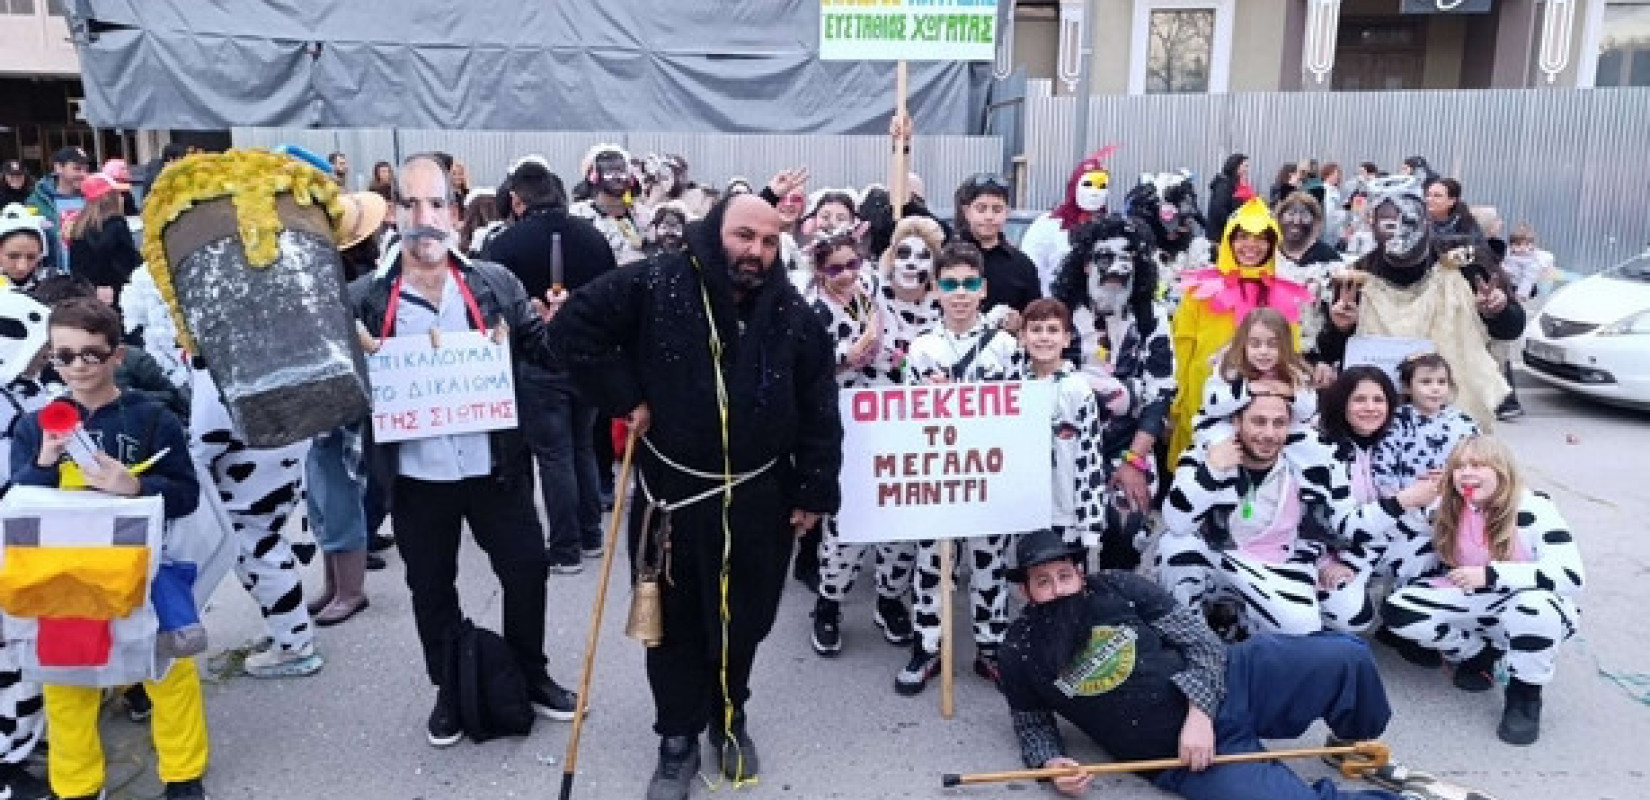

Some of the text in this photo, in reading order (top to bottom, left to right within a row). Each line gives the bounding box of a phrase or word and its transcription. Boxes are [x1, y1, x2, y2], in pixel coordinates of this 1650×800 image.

[372, 371, 510, 402] ΤΟ ΔΙΚΑΙΩΜΑ
[374, 400, 514, 431] ΤΗΣ ΣΙΩΠΗΣ
[851, 383, 1023, 422] ΟΠΕΚΕΠΕ
[922, 425, 958, 446] ΤΟ
[873, 447, 1004, 478] ΜΕΓΑΛΟ
[877, 478, 988, 508] ΜΑΝΤΡΙ
